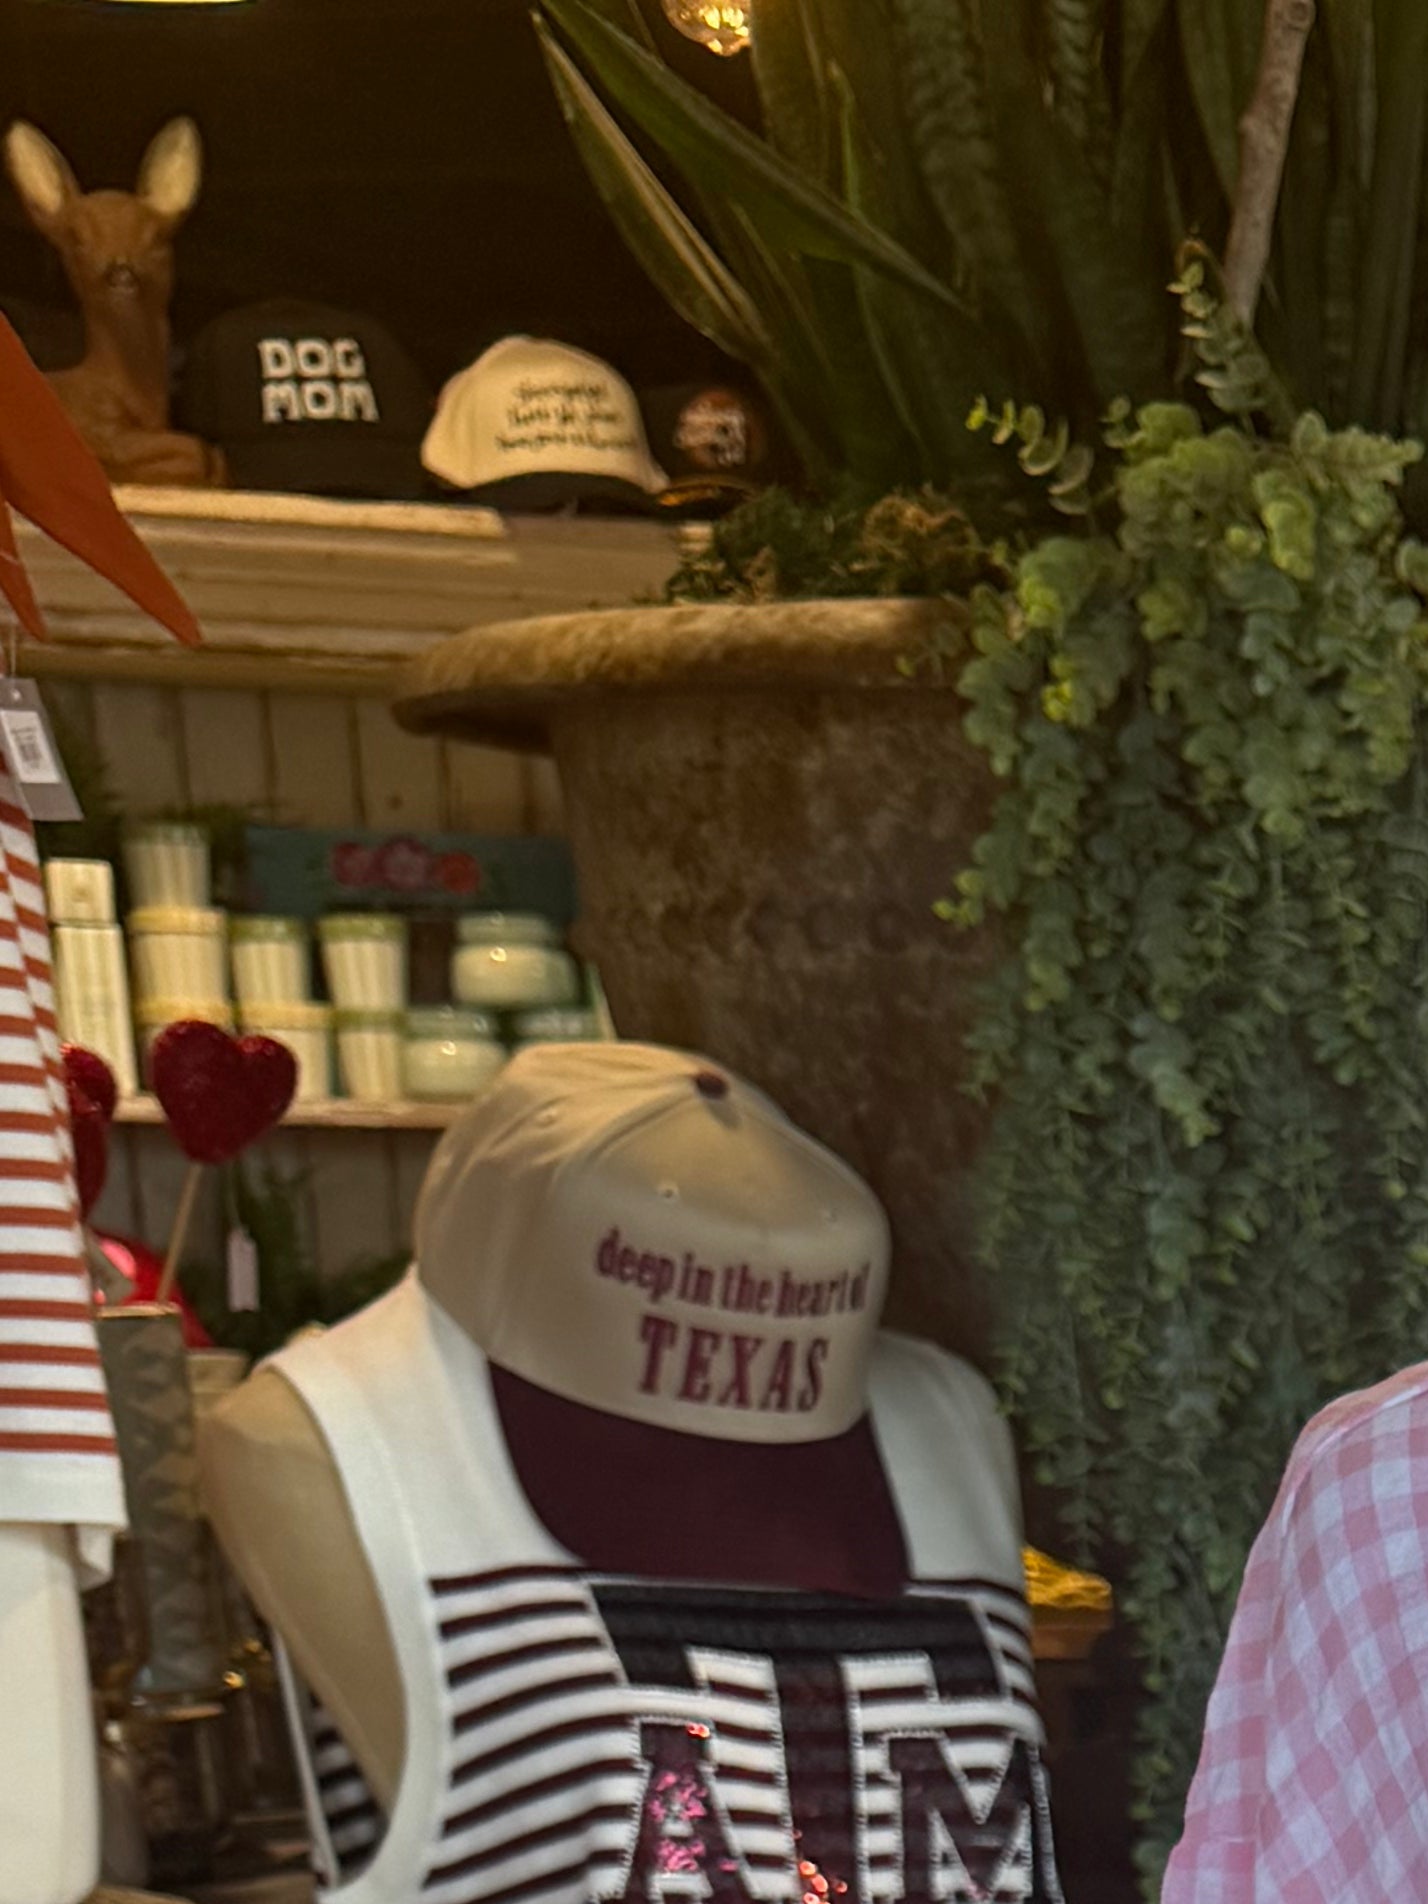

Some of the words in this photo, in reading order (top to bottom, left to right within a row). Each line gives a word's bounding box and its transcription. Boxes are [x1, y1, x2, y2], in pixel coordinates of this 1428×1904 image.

[258, 339, 367, 379] DOG
[262, 380, 380, 423] MOM
[596, 1226, 674, 1304] deep
[678, 1253, 714, 1306] in
[721, 1264, 774, 1314] the
[776, 1267, 848, 1317] heart
[638, 1314, 829, 1413] TEXAS
